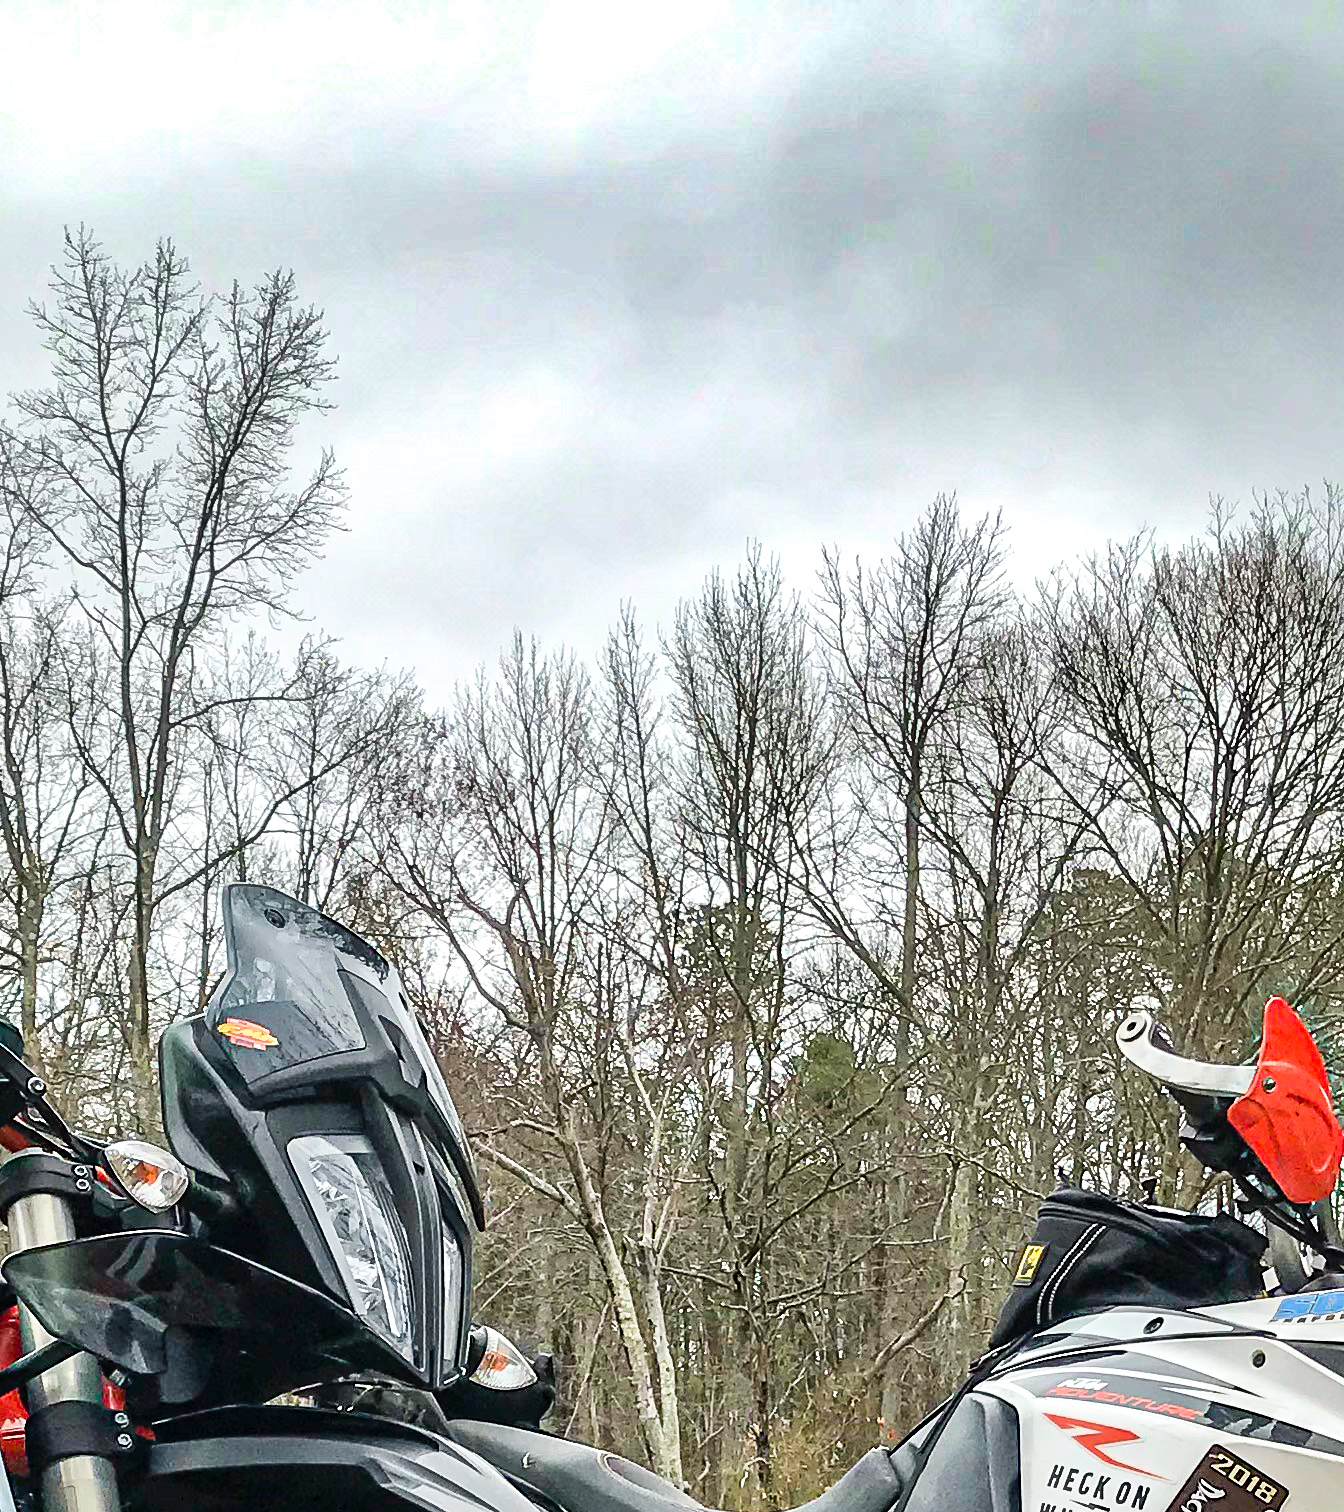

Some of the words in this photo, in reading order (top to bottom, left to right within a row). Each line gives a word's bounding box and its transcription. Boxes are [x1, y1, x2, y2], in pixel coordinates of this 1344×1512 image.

[1046, 1387, 1205, 1420] ADVENTURE
[1056, 1377, 1109, 1391] KTM
[1047, 1465, 1111, 1500] HECK
[1116, 1481, 1150, 1510] ON
[1210, 1453, 1278, 1504] 2018
